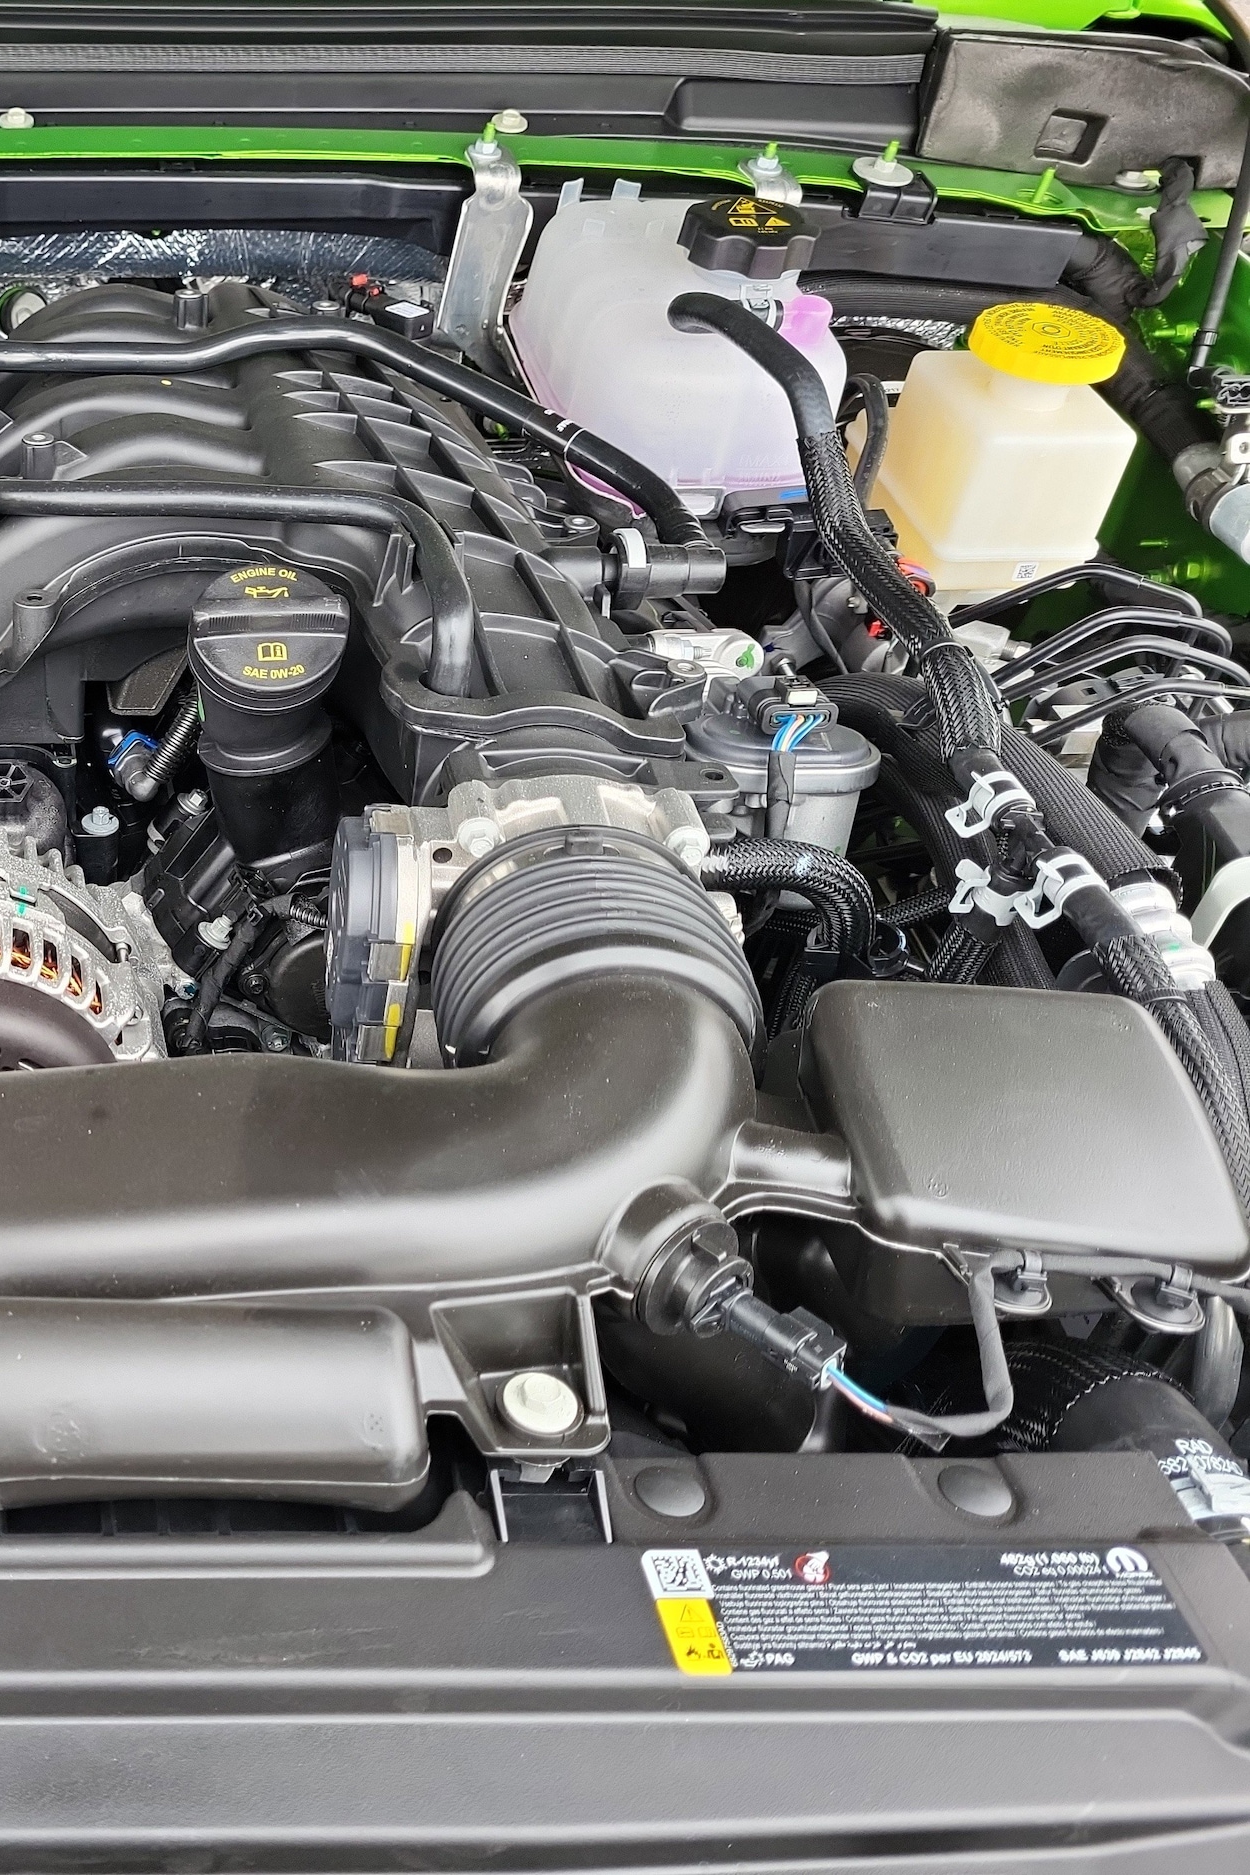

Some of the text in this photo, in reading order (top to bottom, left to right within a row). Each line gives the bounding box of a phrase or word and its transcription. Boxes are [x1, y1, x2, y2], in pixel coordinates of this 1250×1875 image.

[230, 567, 298, 584] ENGINE OIL
[242, 664, 305, 679] SAE 0W-20
[1175, 1438, 1213, 1455] RAD
[730, 1568, 793, 1580] GWP 0.501
[1013, 1565, 1041, 1577] CO2
[765, 1652, 795, 1666] PAG
[851, 1651, 884, 1666] GWP
[900, 1650, 929, 1665] CO2
[930, 1652, 952, 1666] per
[953, 1650, 974, 1664] EU
[1058, 1649, 1089, 1663] SAE
